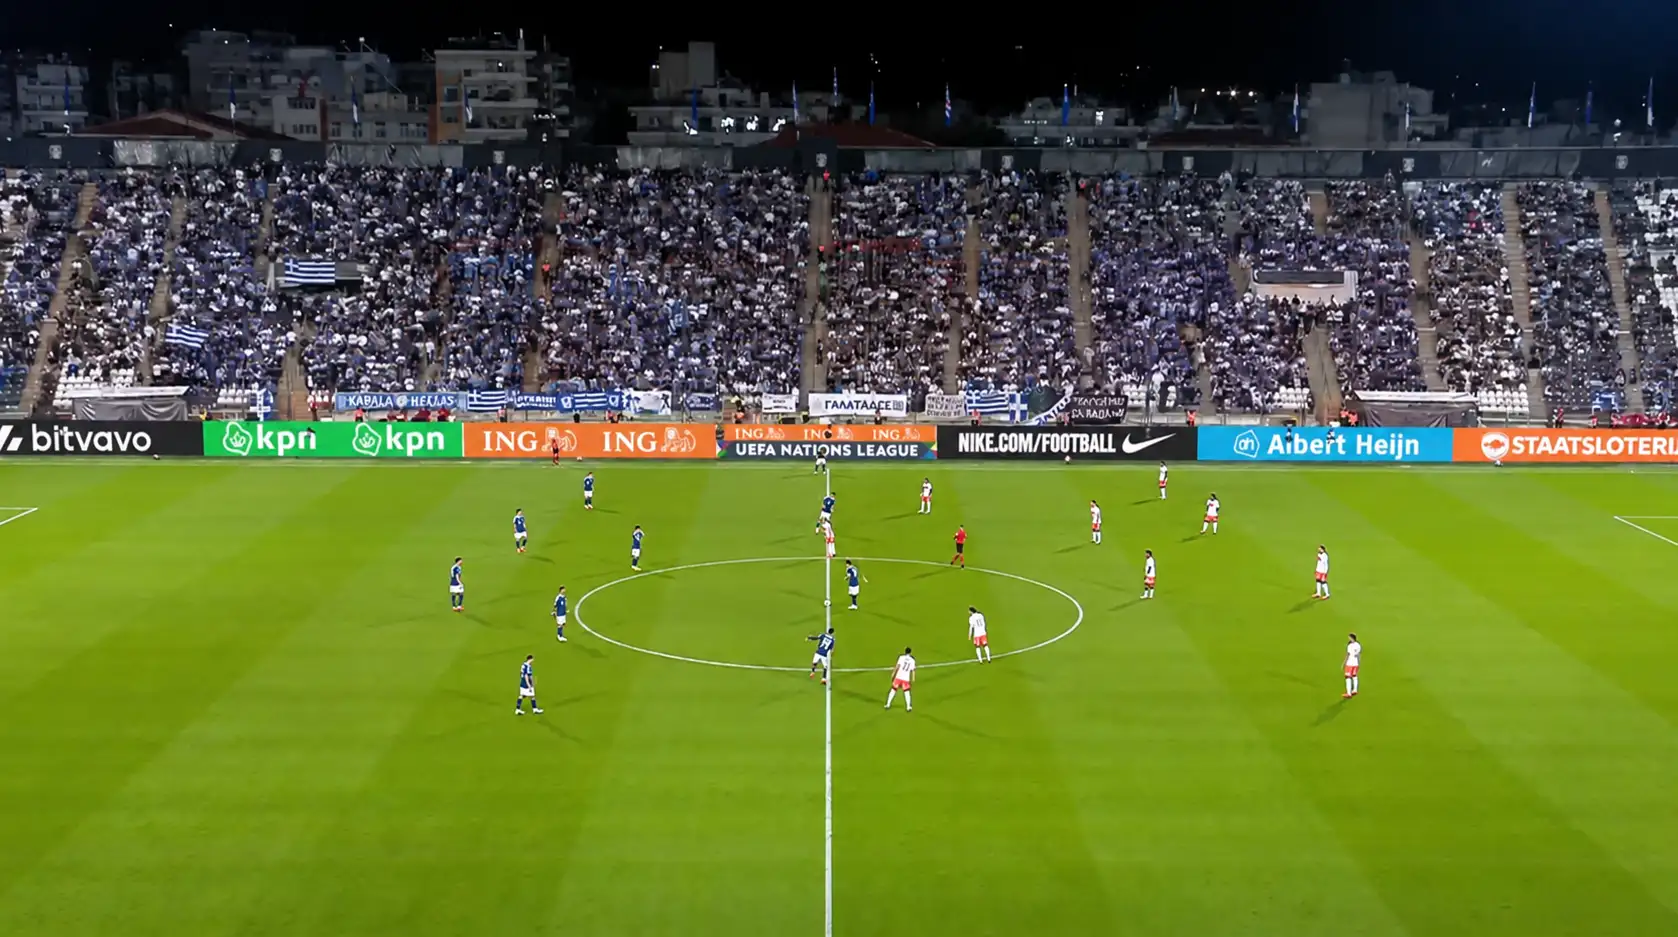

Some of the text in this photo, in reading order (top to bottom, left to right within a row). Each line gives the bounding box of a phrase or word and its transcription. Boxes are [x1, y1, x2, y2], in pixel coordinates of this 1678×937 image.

[31, 423, 152, 452] bitvavo
[256, 423, 317, 457] kpn
[386, 424, 445, 457] kpn
[483, 430, 539, 452] ING
[603, 430, 658, 452] ING
[735, 427, 764, 440] ING
[872, 428, 901, 441] ING
[958, 432, 1117, 453] NIKE.COM/FOOTBALL
[735, 443, 919, 457] UEFA NATIONS LEAGUE
[1266, 433, 1420, 461] Albert Heijn
